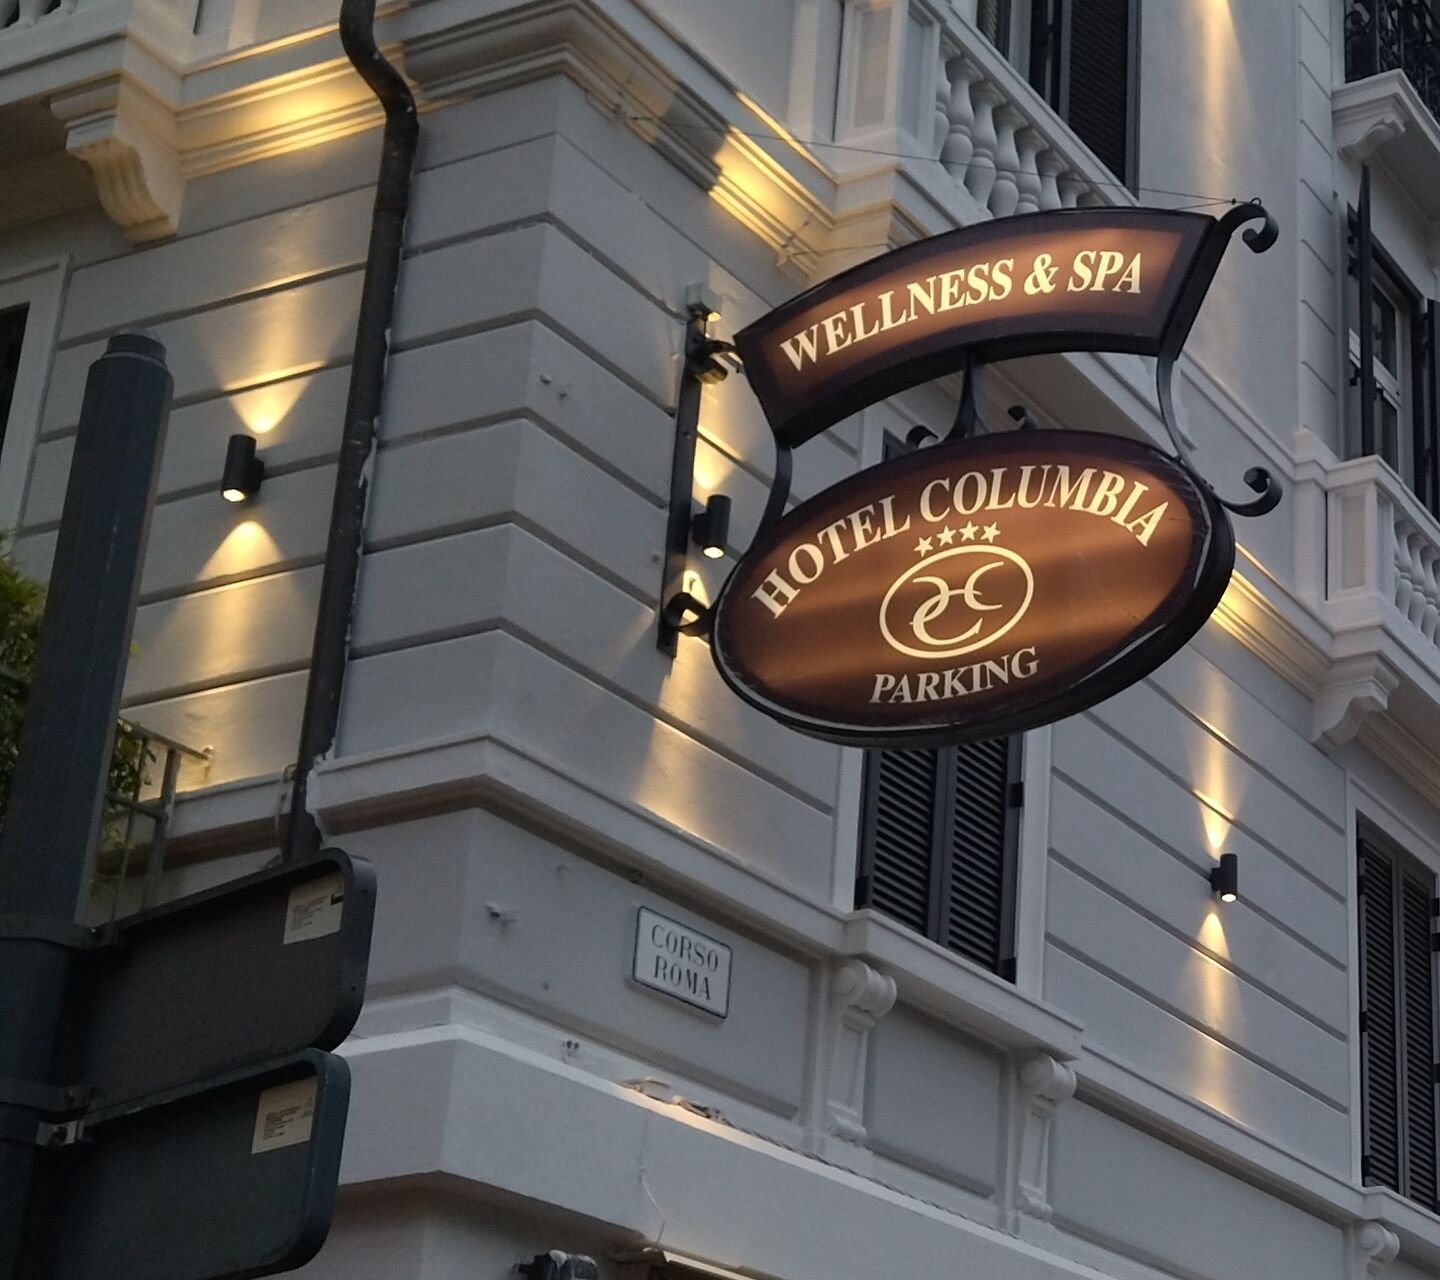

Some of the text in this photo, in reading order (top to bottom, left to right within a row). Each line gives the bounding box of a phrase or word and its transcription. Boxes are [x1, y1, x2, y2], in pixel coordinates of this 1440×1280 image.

[779, 250, 1142, 373] WELLNESS & SPA
[750, 464, 1170, 619] HOTEL COLUMBIA
[868, 646, 1040, 705] PARKING
[651, 923, 719, 973] CORSO
[654, 955, 711, 1001] ROMA
